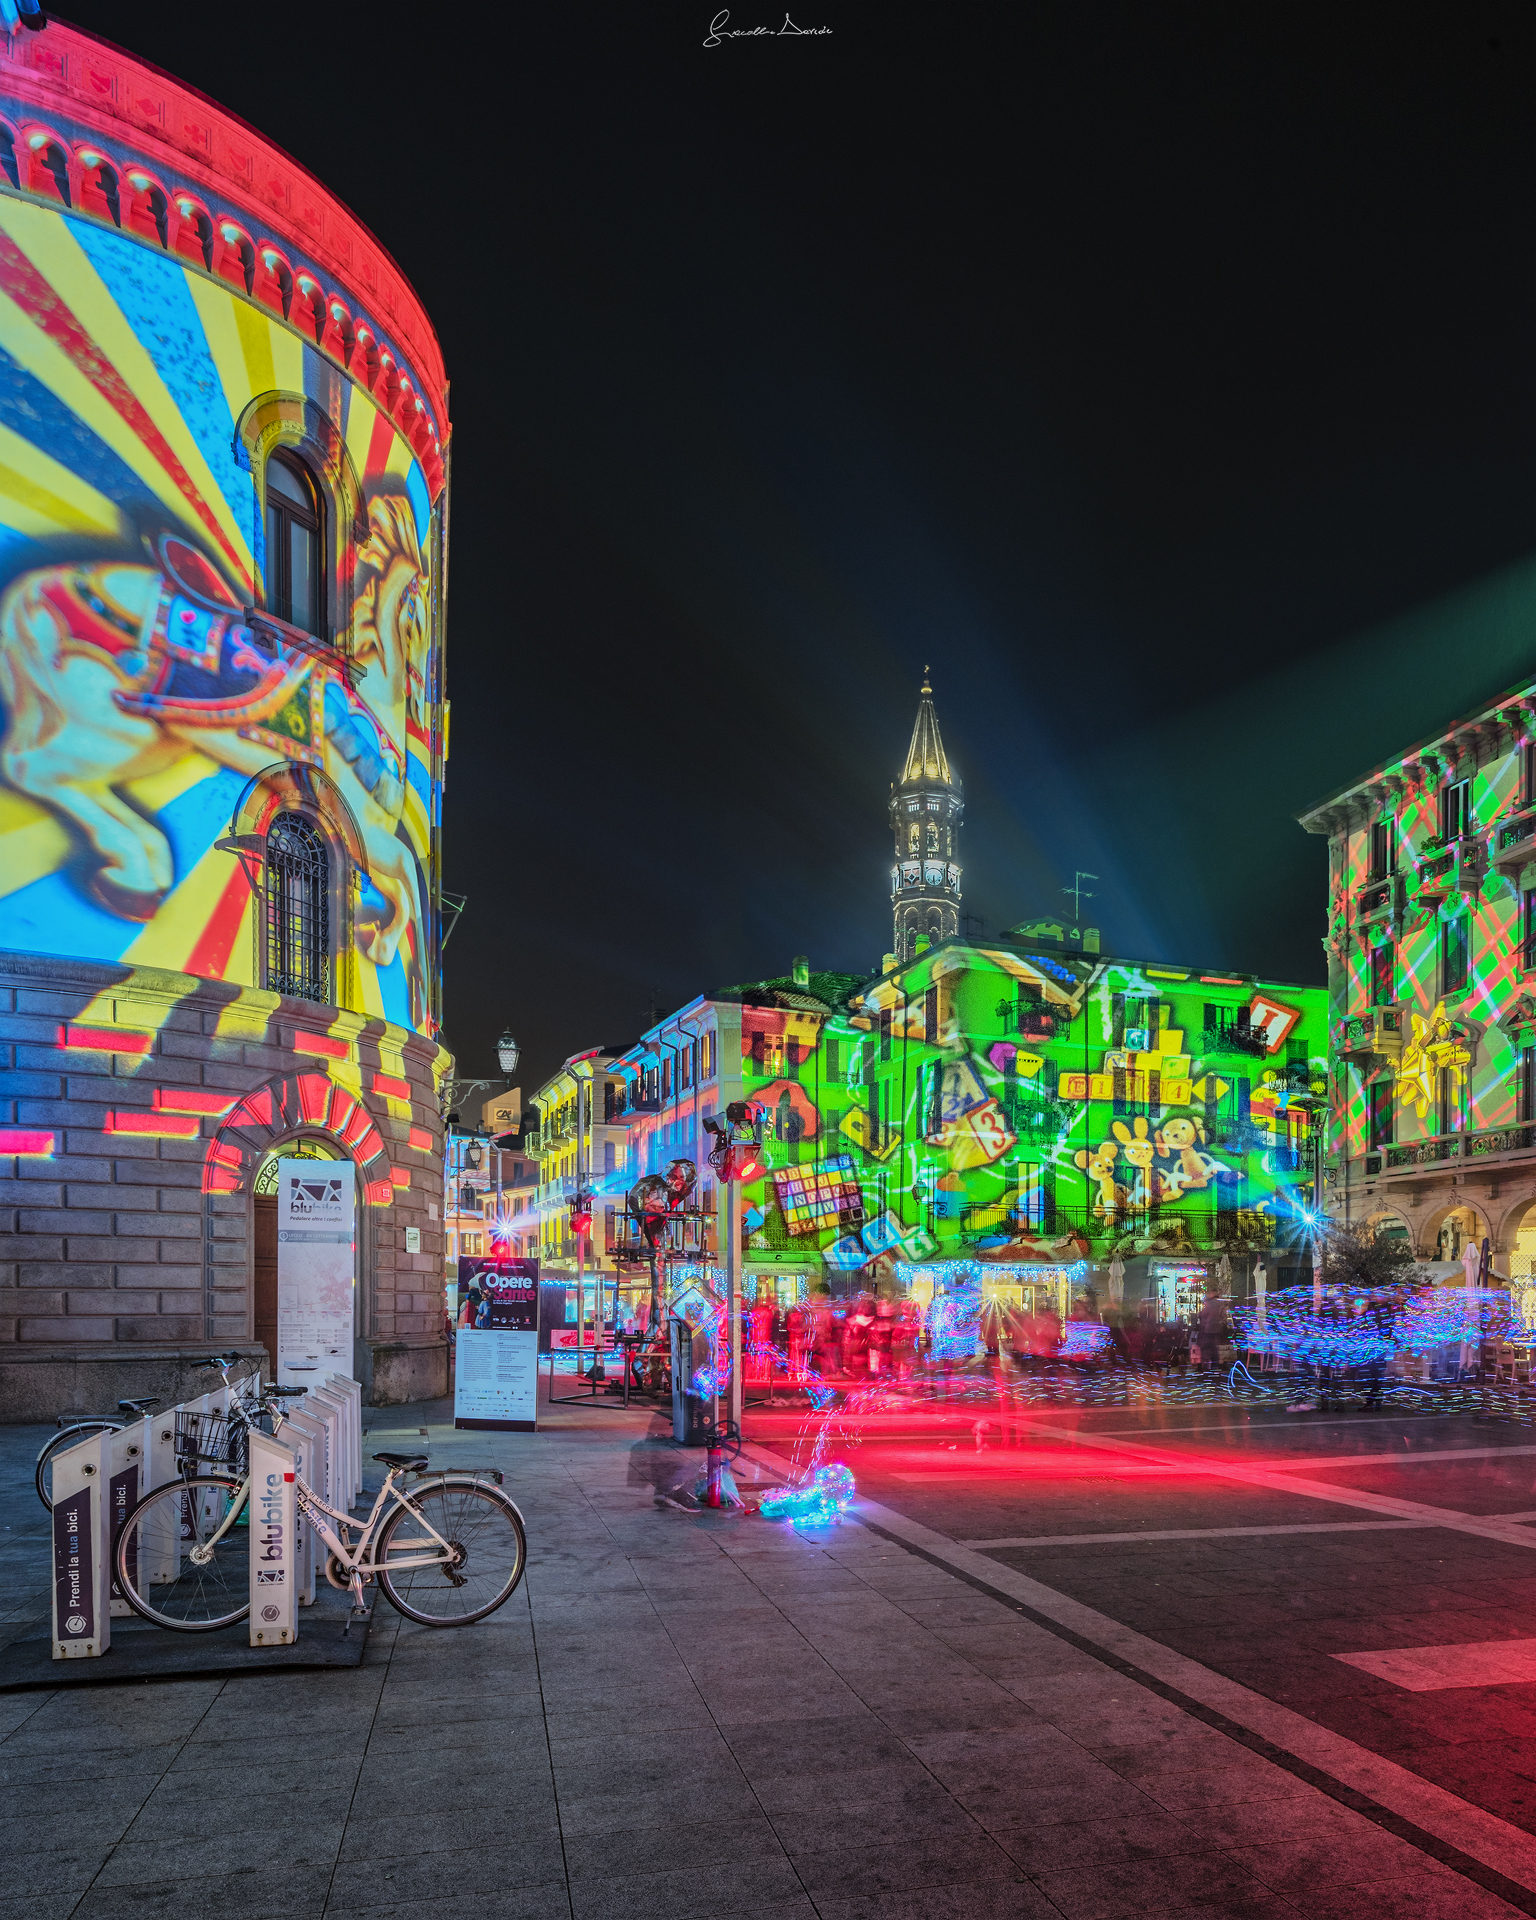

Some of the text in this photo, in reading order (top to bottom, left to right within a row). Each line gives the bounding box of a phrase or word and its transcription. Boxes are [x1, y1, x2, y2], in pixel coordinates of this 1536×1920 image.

[1170, 1085, 1182, 1099] 4
[980, 1111, 1006, 1150] 3
[290, 1201, 342, 1214] blubike
[485, 1272, 533, 1292] Opere
[493, 1285, 537, 1301] Sante
[116, 1484, 127, 1506] bici.
[315, 1497, 334, 1513] Lecco
[259, 1473, 284, 1561] blubike
[66, 1508, 81, 1608] Prendi la tua bici.
